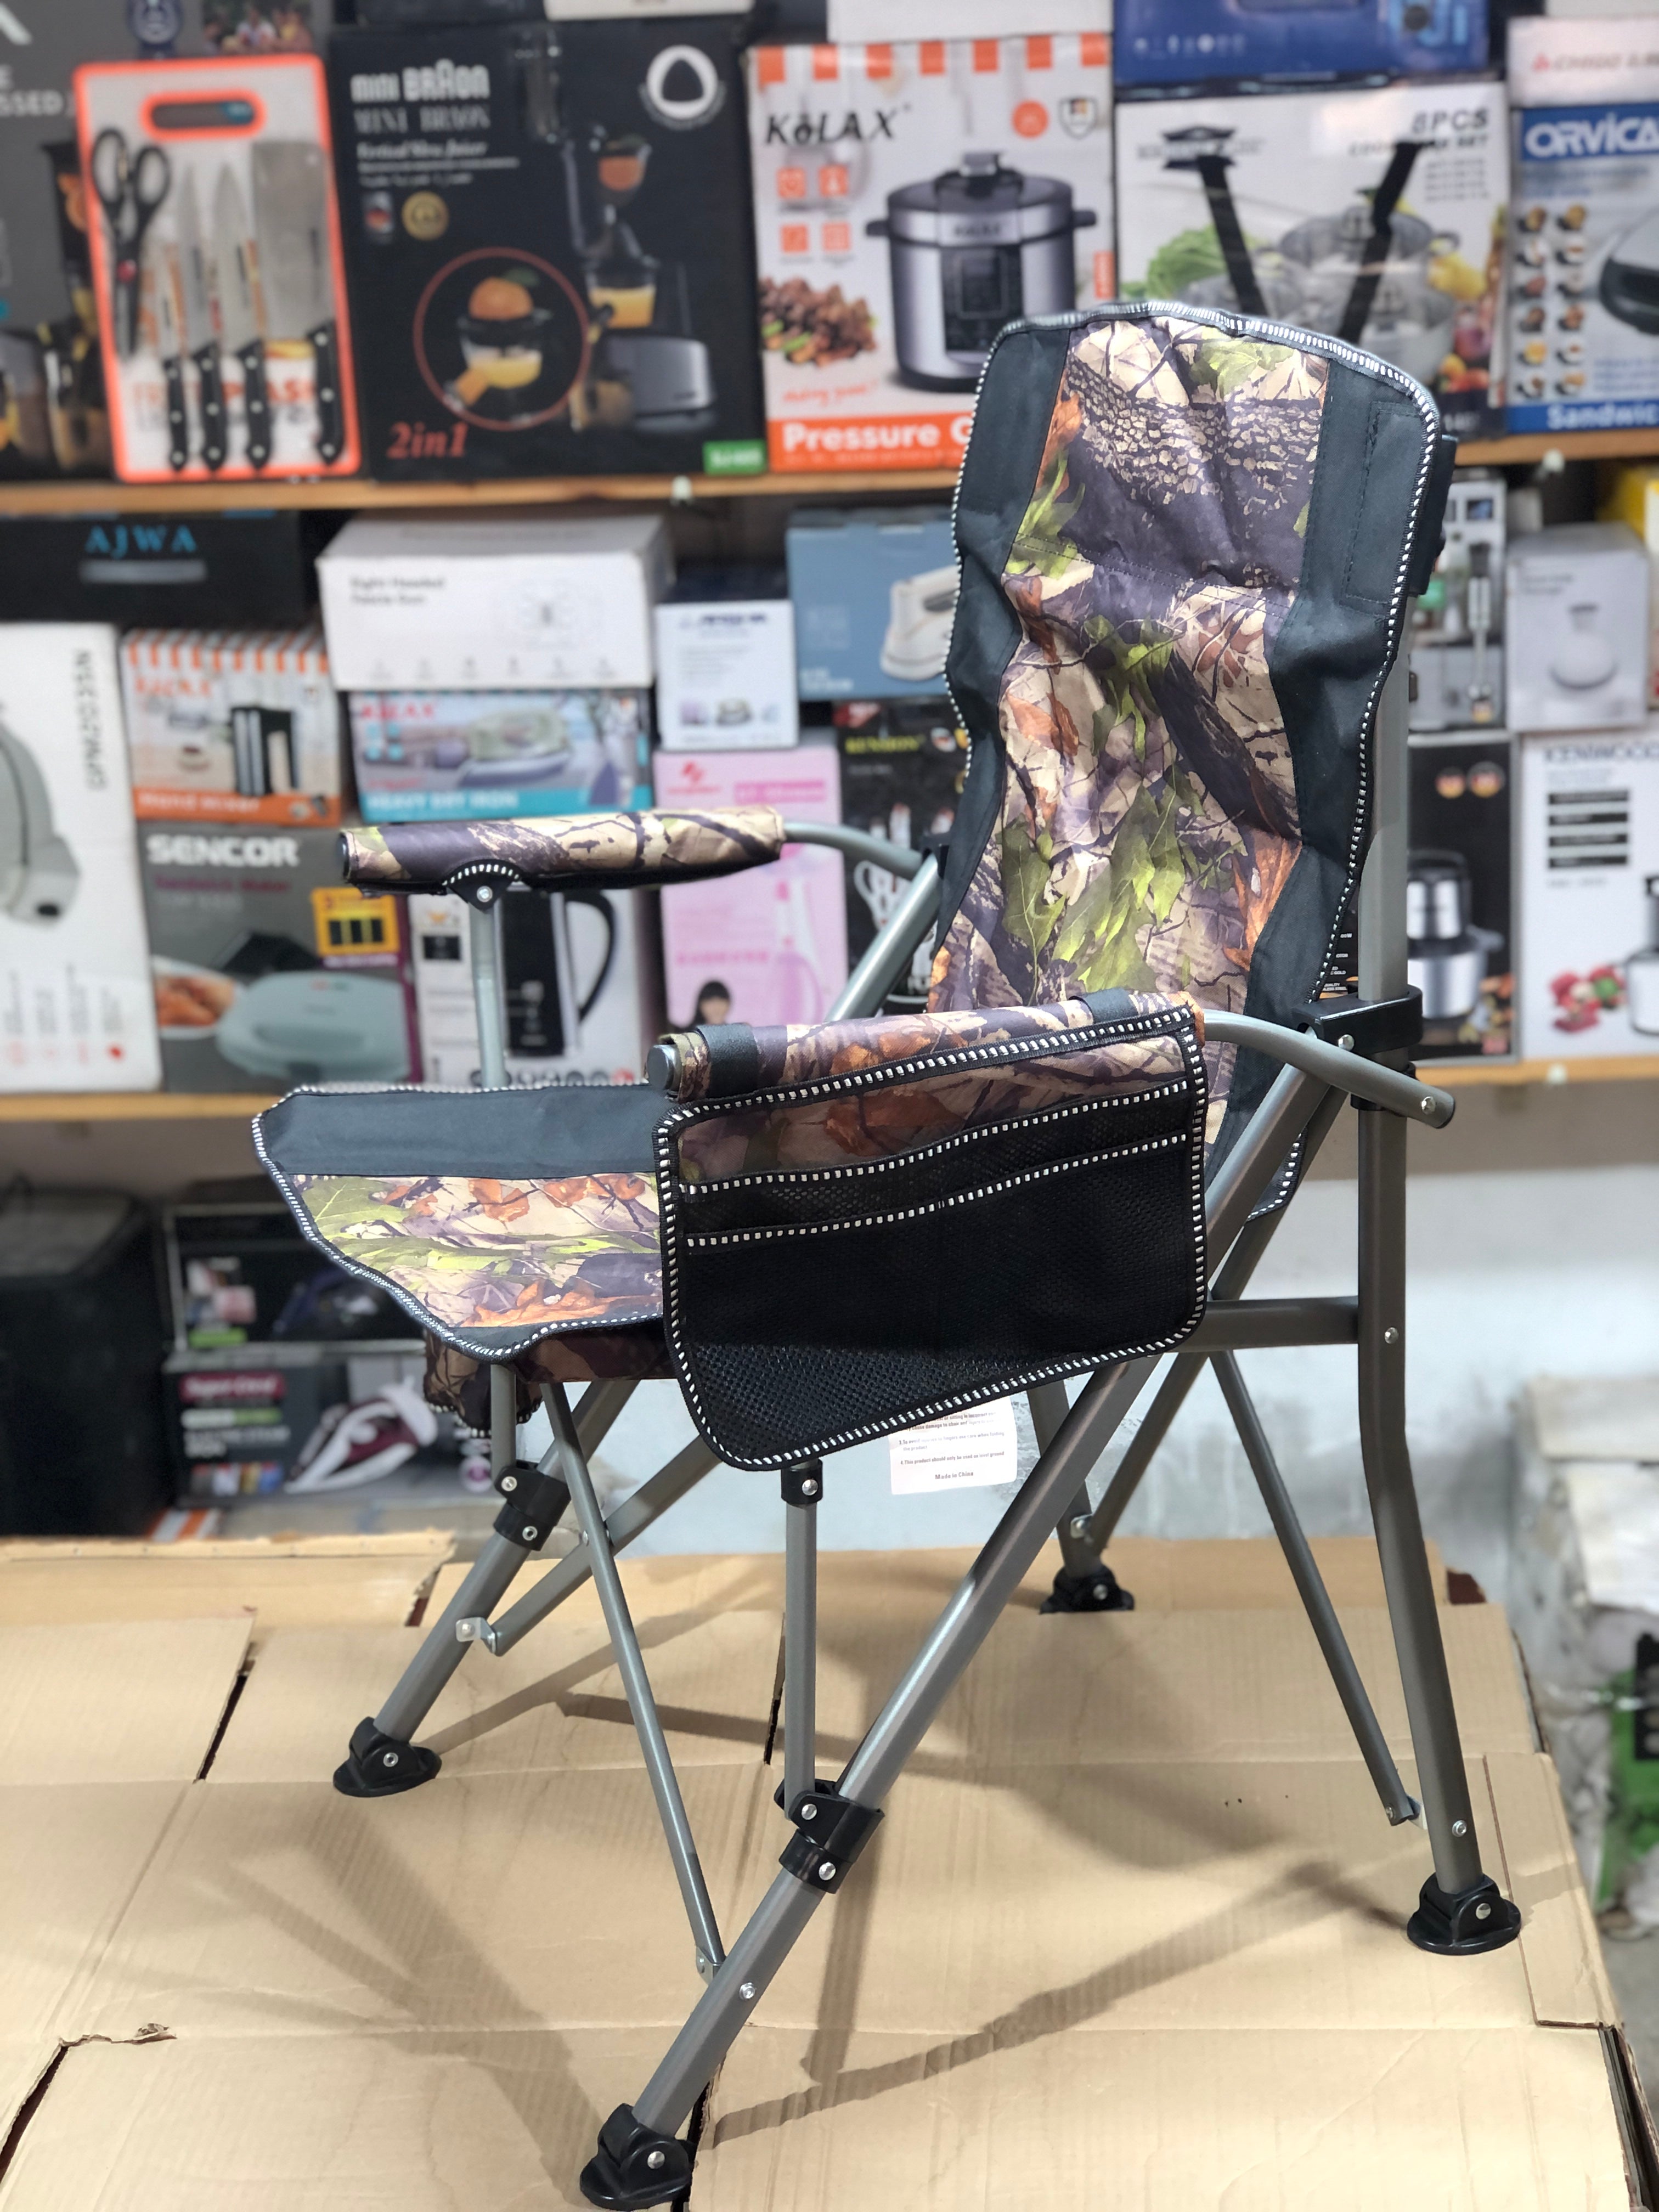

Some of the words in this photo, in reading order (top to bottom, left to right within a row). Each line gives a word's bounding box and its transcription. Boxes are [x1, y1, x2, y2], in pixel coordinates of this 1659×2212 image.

[387, 422, 468, 458] 2in1
[783, 422, 940, 453] Pressure
[84, 524, 197, 560] AJWA
[146, 834, 300, 868] SENCOR
